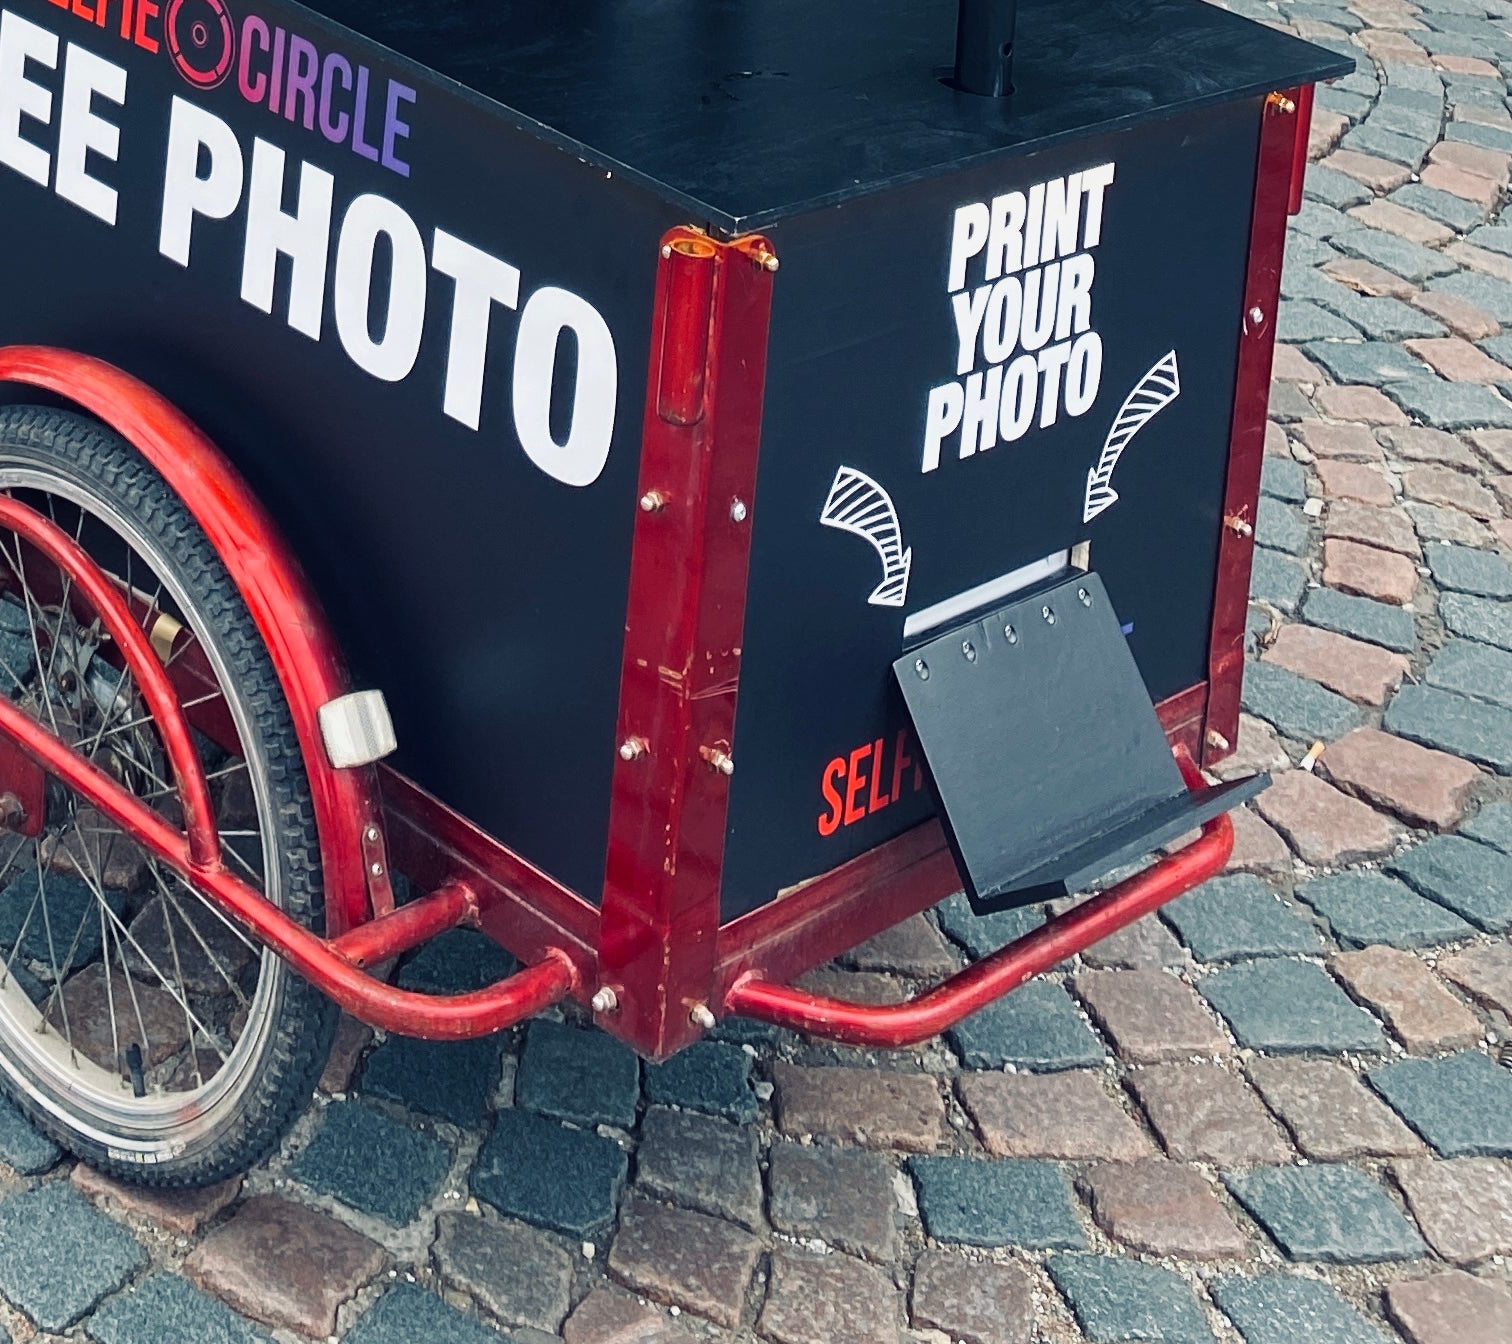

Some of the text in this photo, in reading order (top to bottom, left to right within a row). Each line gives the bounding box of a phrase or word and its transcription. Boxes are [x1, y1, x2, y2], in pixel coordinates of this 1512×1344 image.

[238, 15, 417, 178] CIRCLE
[158, 94, 619, 488] PHOTO
[948, 162, 1116, 293] PRINT
[951, 253, 1096, 376] YOUR
[921, 331, 1104, 474] PHOTO
